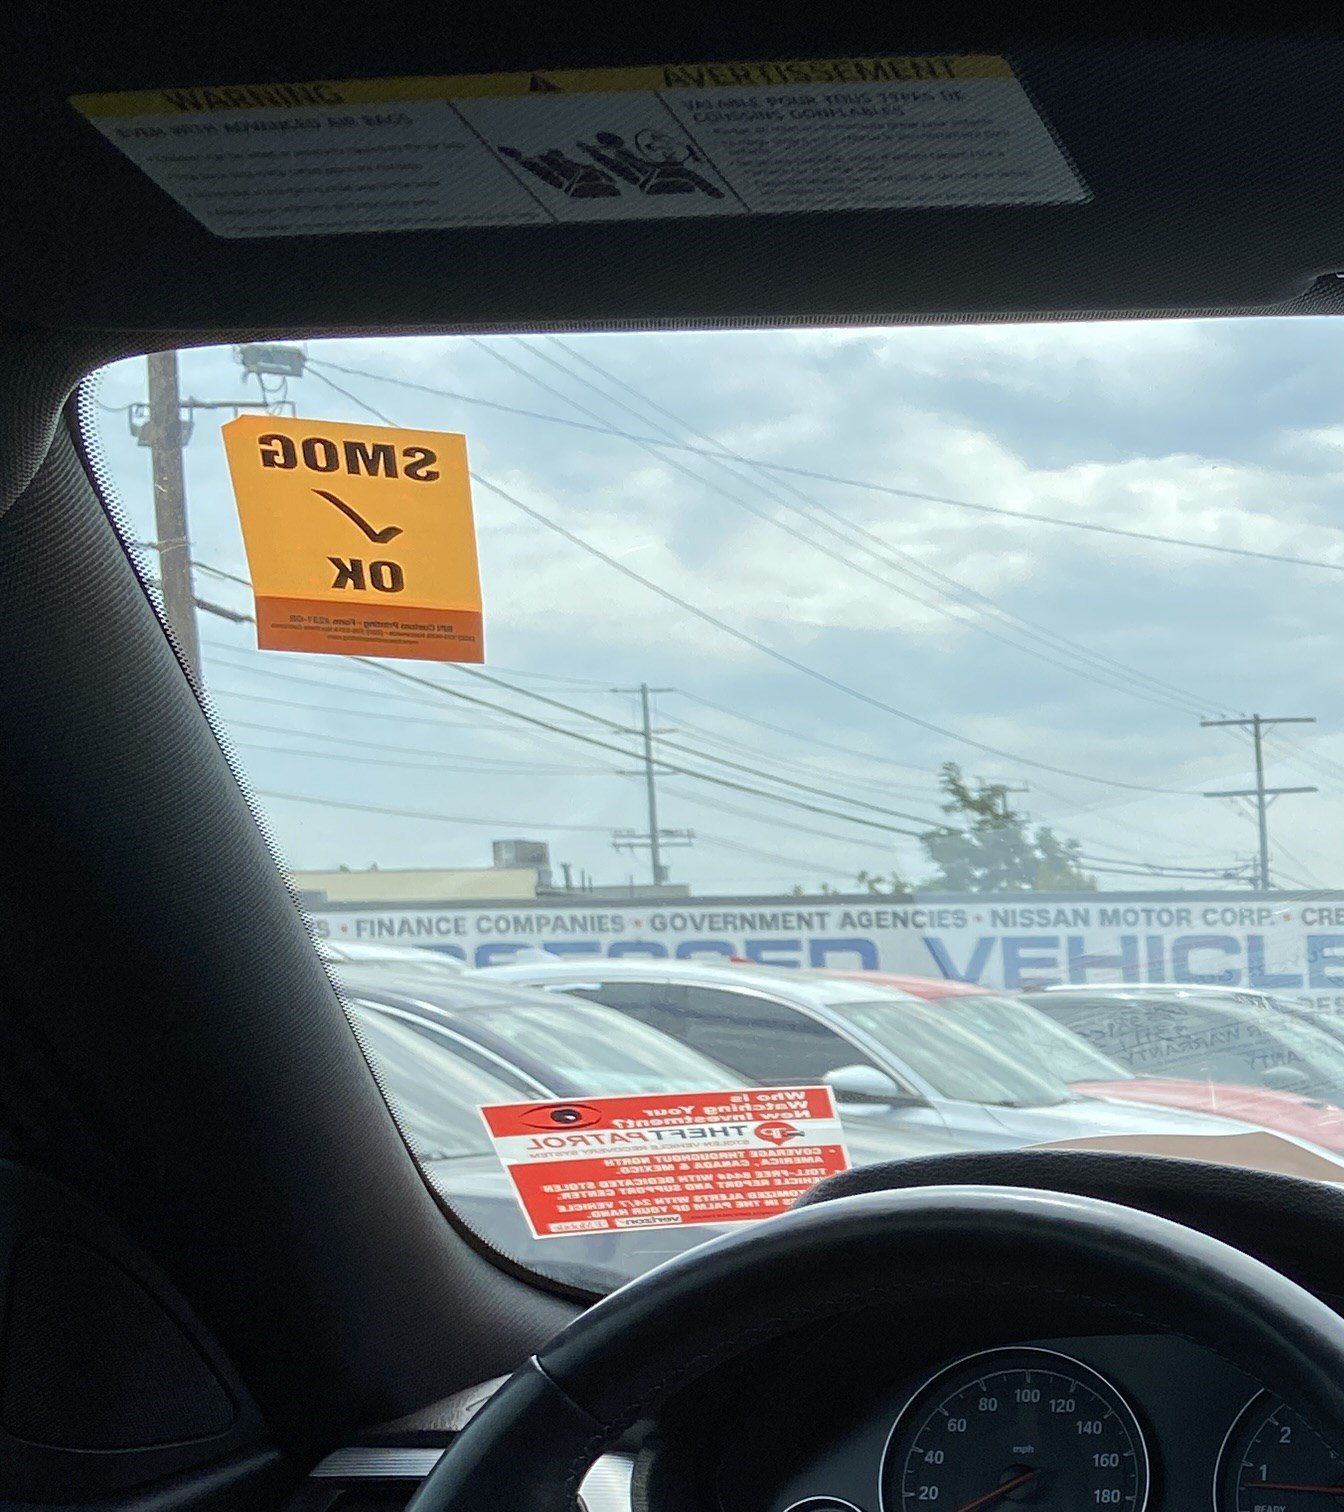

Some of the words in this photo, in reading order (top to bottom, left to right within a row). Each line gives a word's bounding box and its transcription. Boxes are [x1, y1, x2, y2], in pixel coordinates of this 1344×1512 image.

[663, 59, 957, 87] AVERTISSEMENT
[163, 83, 345, 112] WARNING
[356, 915, 467, 938] FINANCE
[476, 913, 625, 936] COMPANIES
[651, 911, 830, 933] GOVERNMENT
[840, 908, 968, 930] AGENCIES
[990, 907, 1092, 928] NISSAN
[1098, 907, 1197, 927] MOTOR
[1202, 906, 1276, 927] CORP.
[1015, 1389, 1040, 1403] 100
[978, 1397, 998, 1411] 80
[1050, 1399, 1076, 1413] 120
[947, 1419, 967, 1432] 60
[1076, 1421, 1102, 1435] 140
[1279, 1426, 1291, 1444] 2
[924, 1450, 944, 1464] 40
[1092, 1453, 1119, 1467] 160
[1260, 1464, 1267, 1481] 1
[919, 1486, 939, 1499] 20
[1094, 1490, 1120, 1504] 180
